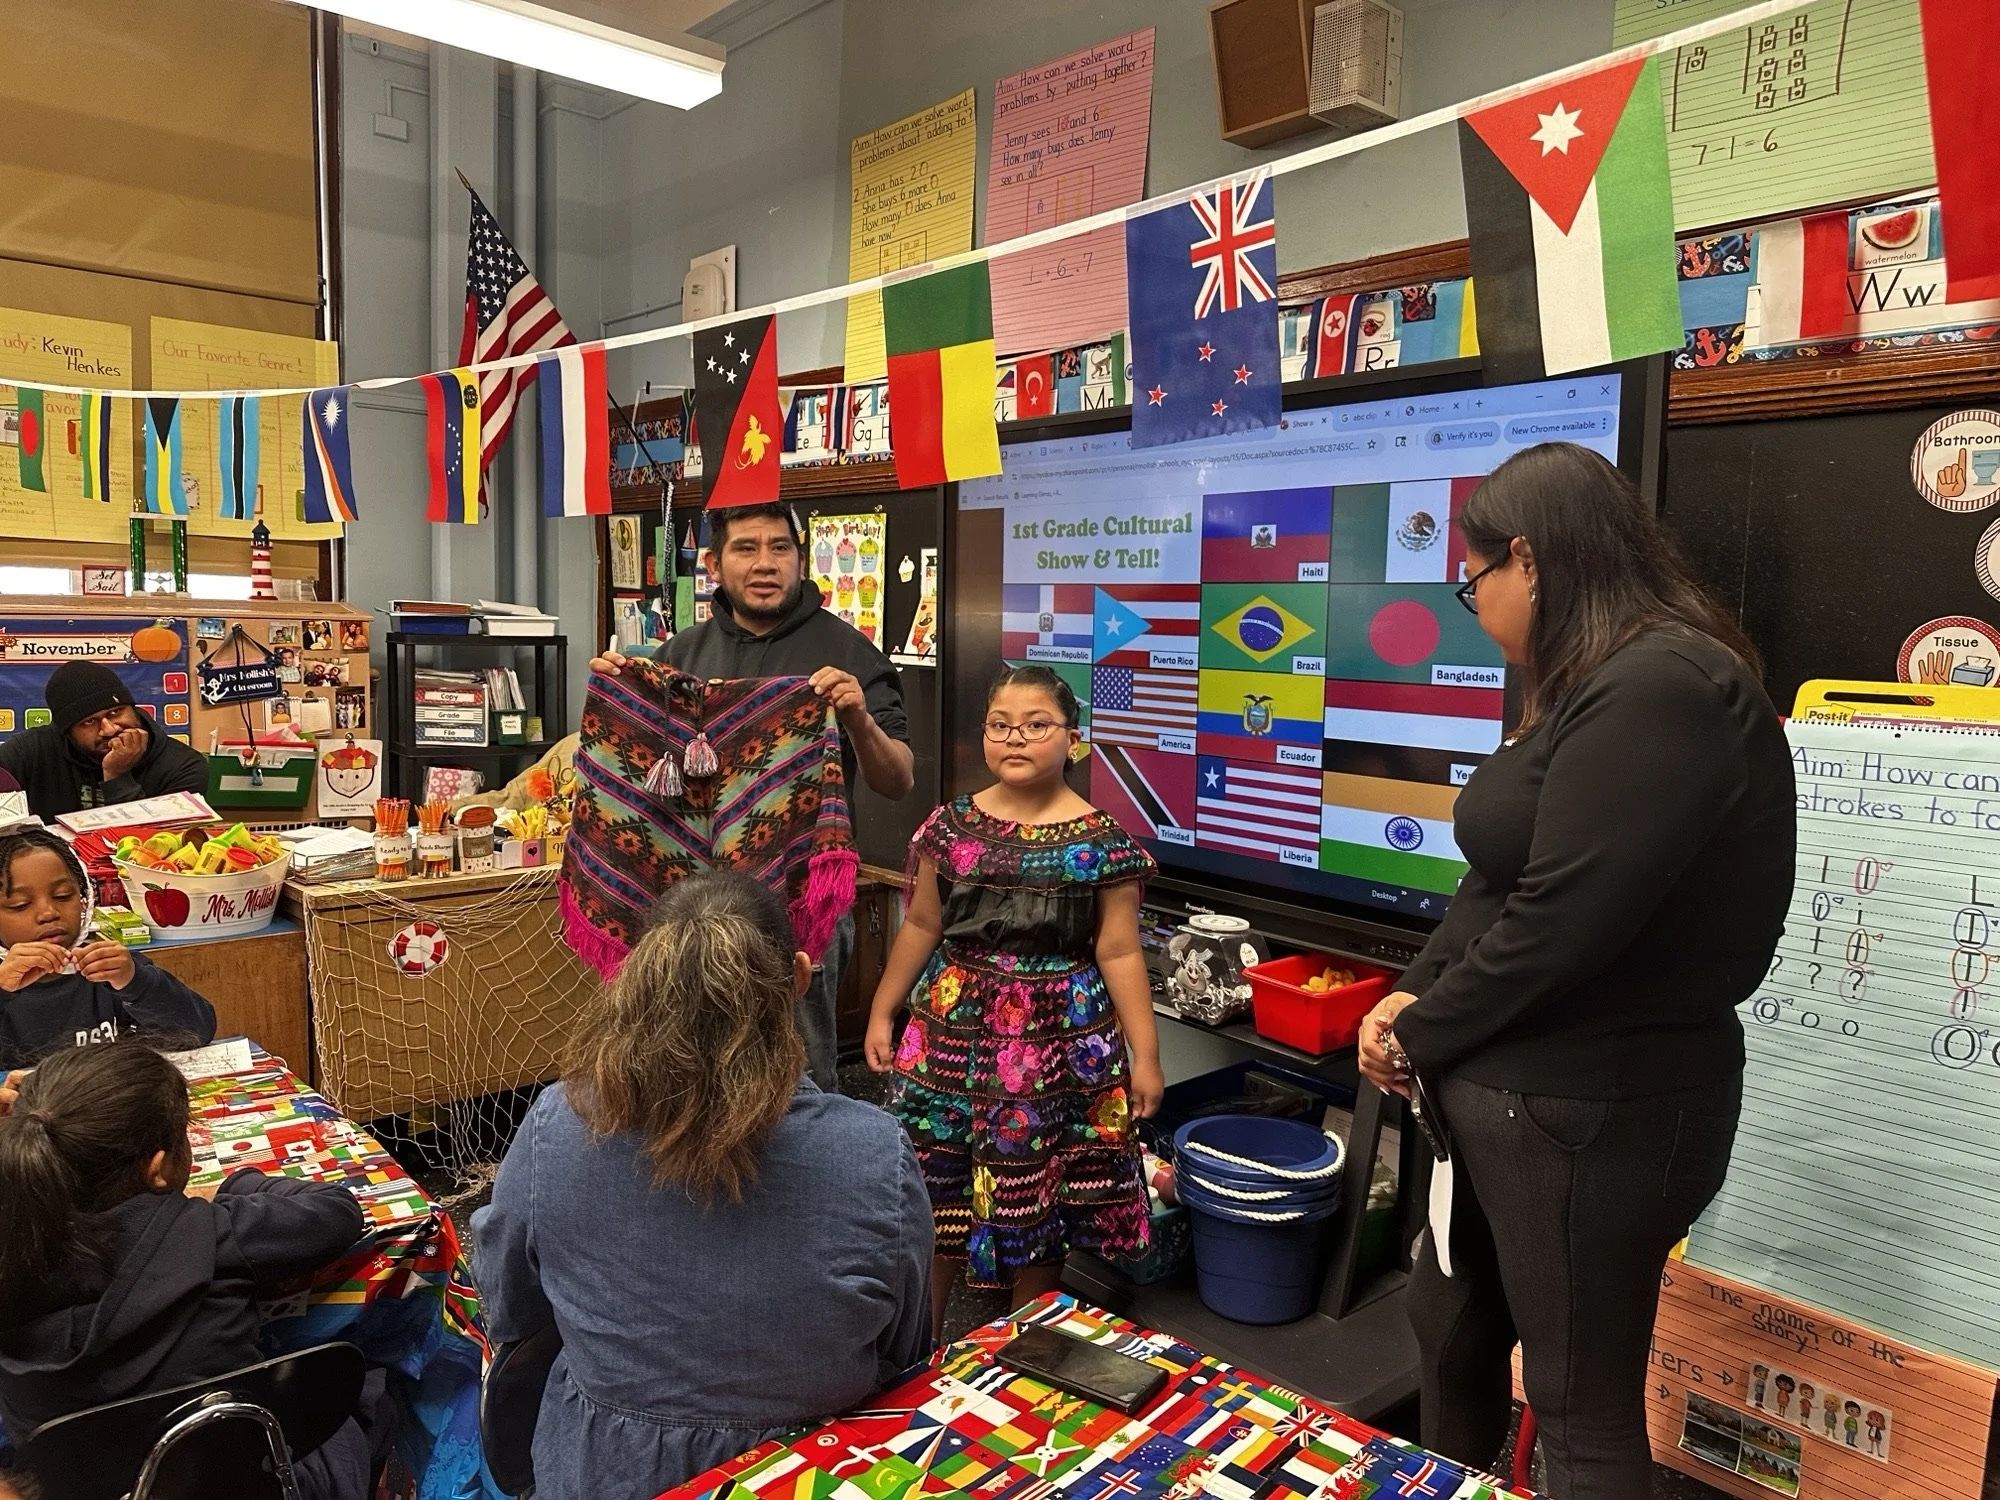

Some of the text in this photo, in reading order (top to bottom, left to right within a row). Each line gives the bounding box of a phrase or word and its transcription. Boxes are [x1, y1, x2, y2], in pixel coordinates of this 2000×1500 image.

[1019, 72, 1040, 88] How
[1044, 68, 1060, 80] can
[1064, 61, 1076, 73] we
[1080, 48, 1104, 68] solve
[1107, 35, 1133, 59] word
[1000, 91, 1039, 118] problems
[1046, 83, 1057, 103] by
[873, 128, 892, 146] How
[893, 124, 910, 136] can
[911, 117, 922, 129] we
[924, 106, 945, 123] solve
[947, 92, 968, 113] word
[1004, 132, 1028, 149] Jenny
[1031, 127, 1051, 140] sees
[1069, 109, 1087, 129] and
[1093, 106, 1100, 122] 6
[859, 146, 896, 174] problems
[897, 129, 921, 152] about
[1003, 125, 1116, 167] How many bugs does Jenny
[862, 183, 886, 200] Anna
[889, 174, 904, 189] has
[1000, 177, 1013, 187] see
[862, 183, 928, 216] She buys 6 more
[861, 191, 956, 233] How many does Anna
[861, 233, 875, 249] have
[1056, 258, 1067, 276] 6
[1082, 252, 1093, 273] 7
[1864, 250, 1918, 267] watermelon
[1847, 267, 1938, 315] Ww
[42, 336, 84, 358] Kevin
[162, 340, 189, 359] Our
[198, 343, 250, 367] Favorite
[1365, 346, 1395, 372] Rr
[1419, 404, 1440, 415] Home
[852, 419, 872, 451] Gg
[1446, 430, 1493, 442] Verify it's you
[1512, 420, 1596, 436] New Chrome available
[815, 521, 882, 539] Happy Birthday!
[1012, 511, 1193, 540] 1st Grade Cultural
[1037, 548, 1160, 571] Show & Tell!
[1302, 567, 1324, 577] Haiti
[22, 642, 117, 656] November
[1933, 636, 1979, 648] Tissue
[1028, 648, 1090, 661] Dominican Republic
[1153, 655, 1194, 666] Puerto Rico
[1296, 661, 1321, 672] Brazil
[173, 678, 179, 688] 1
[218, 672, 237, 683] Mrs
[1436, 670, 1499, 683] Bangladesh
[440, 693, 459, 701] Copy
[34, 715, 44, 725] 4
[172, 709, 182, 720] 8
[438, 711, 461, 719] Grade
[1808, 710, 1850, 722] Post-it
[443, 728, 456, 737] File
[1161, 739, 1192, 751] America
[1280, 750, 1316, 763] Ecuador
[1792, 746, 2000, 793] Aim: How can
[1797, 783, 1905, 821] strokes
[1924, 796, 1957, 827] to
[1161, 829, 1190, 842] Trinidad
[1283, 849, 1313, 864] Liberia
[1371, 889, 1398, 903] Desktop
[201, 894, 236, 925] Mrs.
[1960, 949, 1982, 982] T
[1807, 962, 1823, 990] ?
[1703, 1280, 1906, 1370] The name of the
